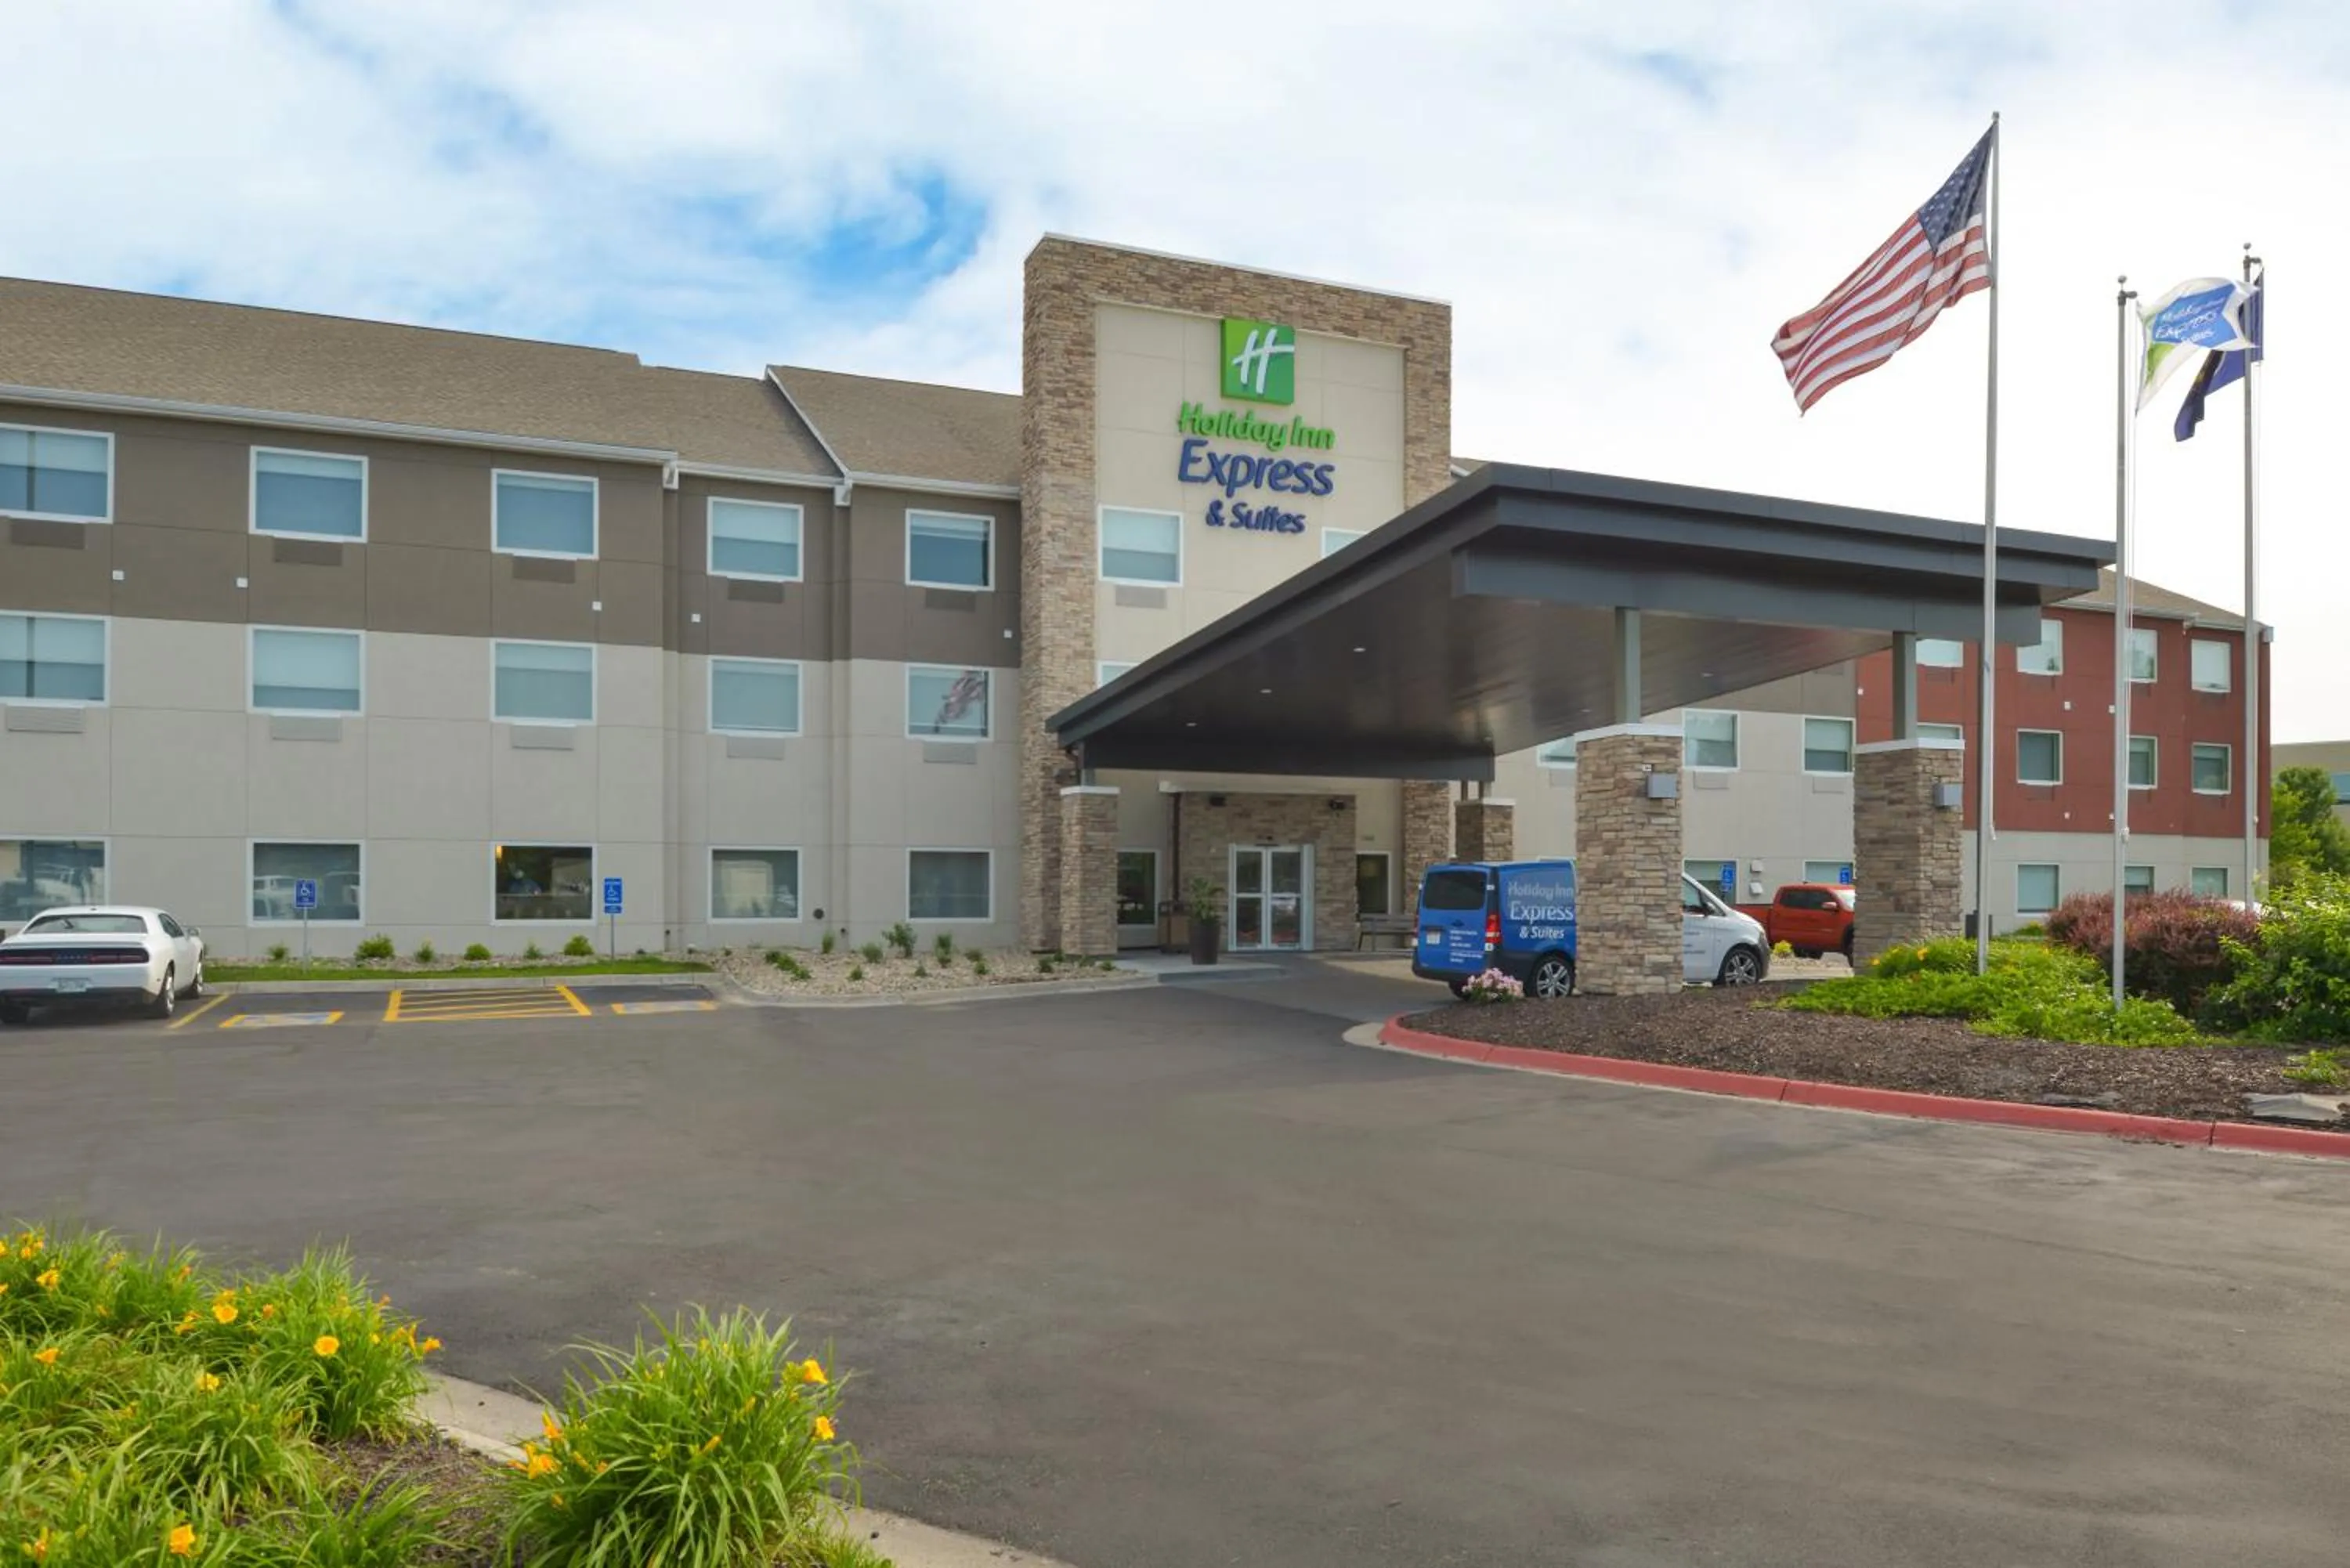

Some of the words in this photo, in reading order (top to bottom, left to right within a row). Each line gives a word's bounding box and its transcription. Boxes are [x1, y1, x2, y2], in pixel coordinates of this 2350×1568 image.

[1178, 401, 1288, 452] Holiday
[1290, 415, 1336, 450] Inn
[1177, 438, 1336, 498] Express
[1206, 500, 1225, 527] &
[1229, 501, 1306, 534] Suites
[1508, 881, 1553, 901] Holiday
[1555, 882, 1574, 898] Inn
[1510, 901, 1574, 925] Express
[1520, 926, 1528, 939] &
[1529, 926, 1564, 939] Suites
